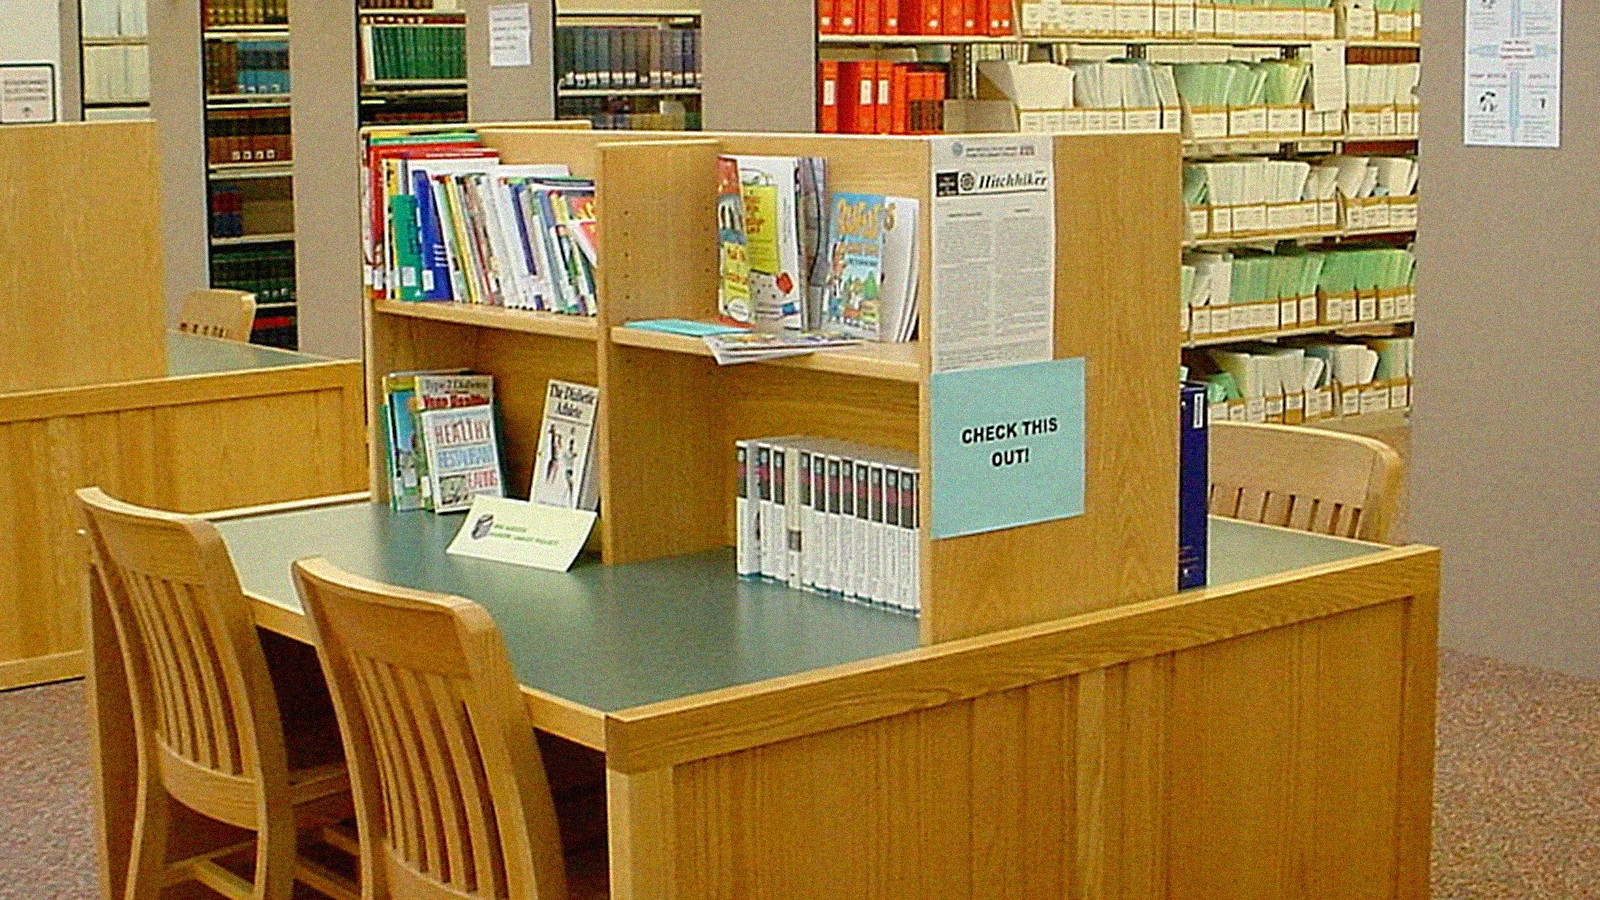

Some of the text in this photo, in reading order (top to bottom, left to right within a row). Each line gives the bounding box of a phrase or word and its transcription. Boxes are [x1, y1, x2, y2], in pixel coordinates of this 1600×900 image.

[979, 172, 1047, 189] Hitchhiker
[425, 379, 445, 392] Type
[564, 386, 595, 404] Diabetic
[435, 419, 491, 443] HEALTHY
[962, 417, 1058, 444] CHECK THIS
[992, 448, 1030, 467] OUT!
